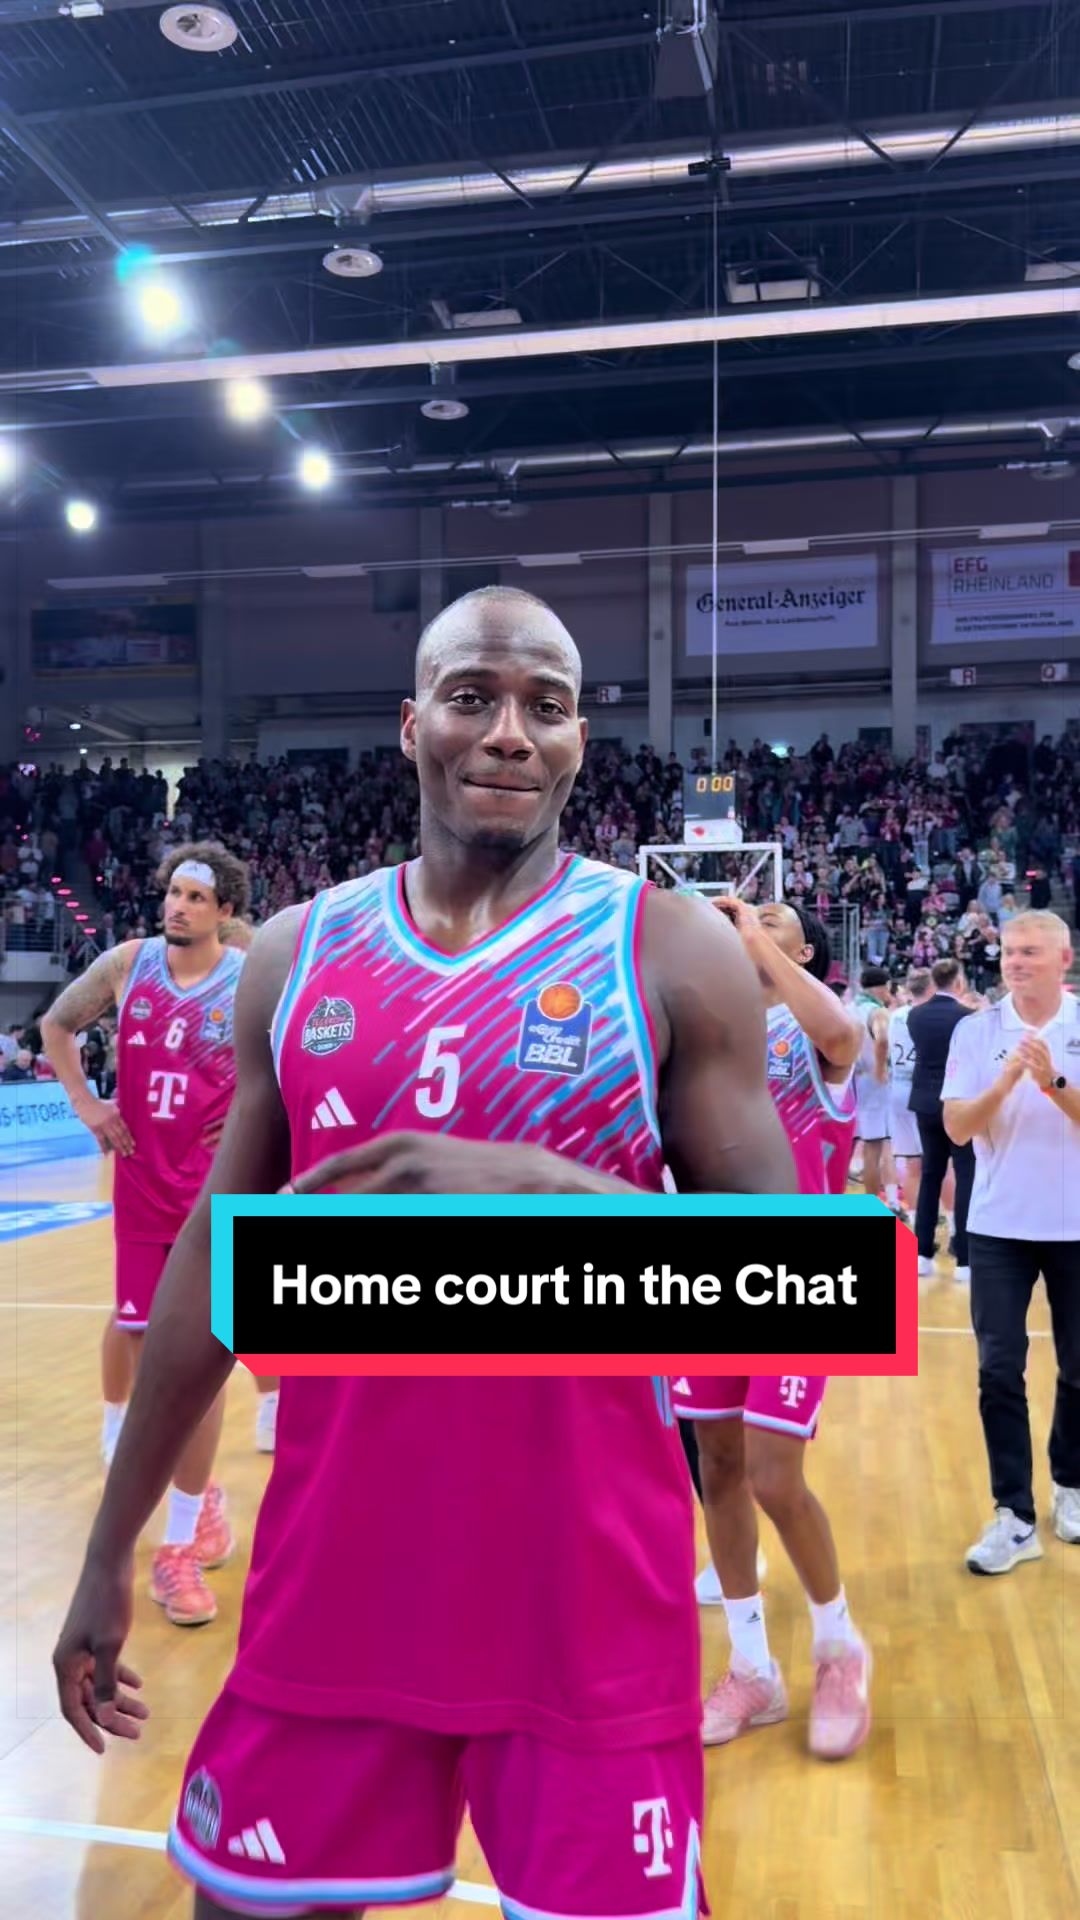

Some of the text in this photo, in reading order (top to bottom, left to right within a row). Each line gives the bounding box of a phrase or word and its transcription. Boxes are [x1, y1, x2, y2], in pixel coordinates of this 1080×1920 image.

[953, 556, 988, 574] EFG
[953, 573, 1055, 593] RHEINLAND
[696, 586, 867, 614] General-Anzeiger
[164, 1017, 188, 1050] 6
[304, 1021, 352, 1044] BASKETS
[524, 1043, 578, 1068] BBL
[415, 1023, 468, 1119] 5
